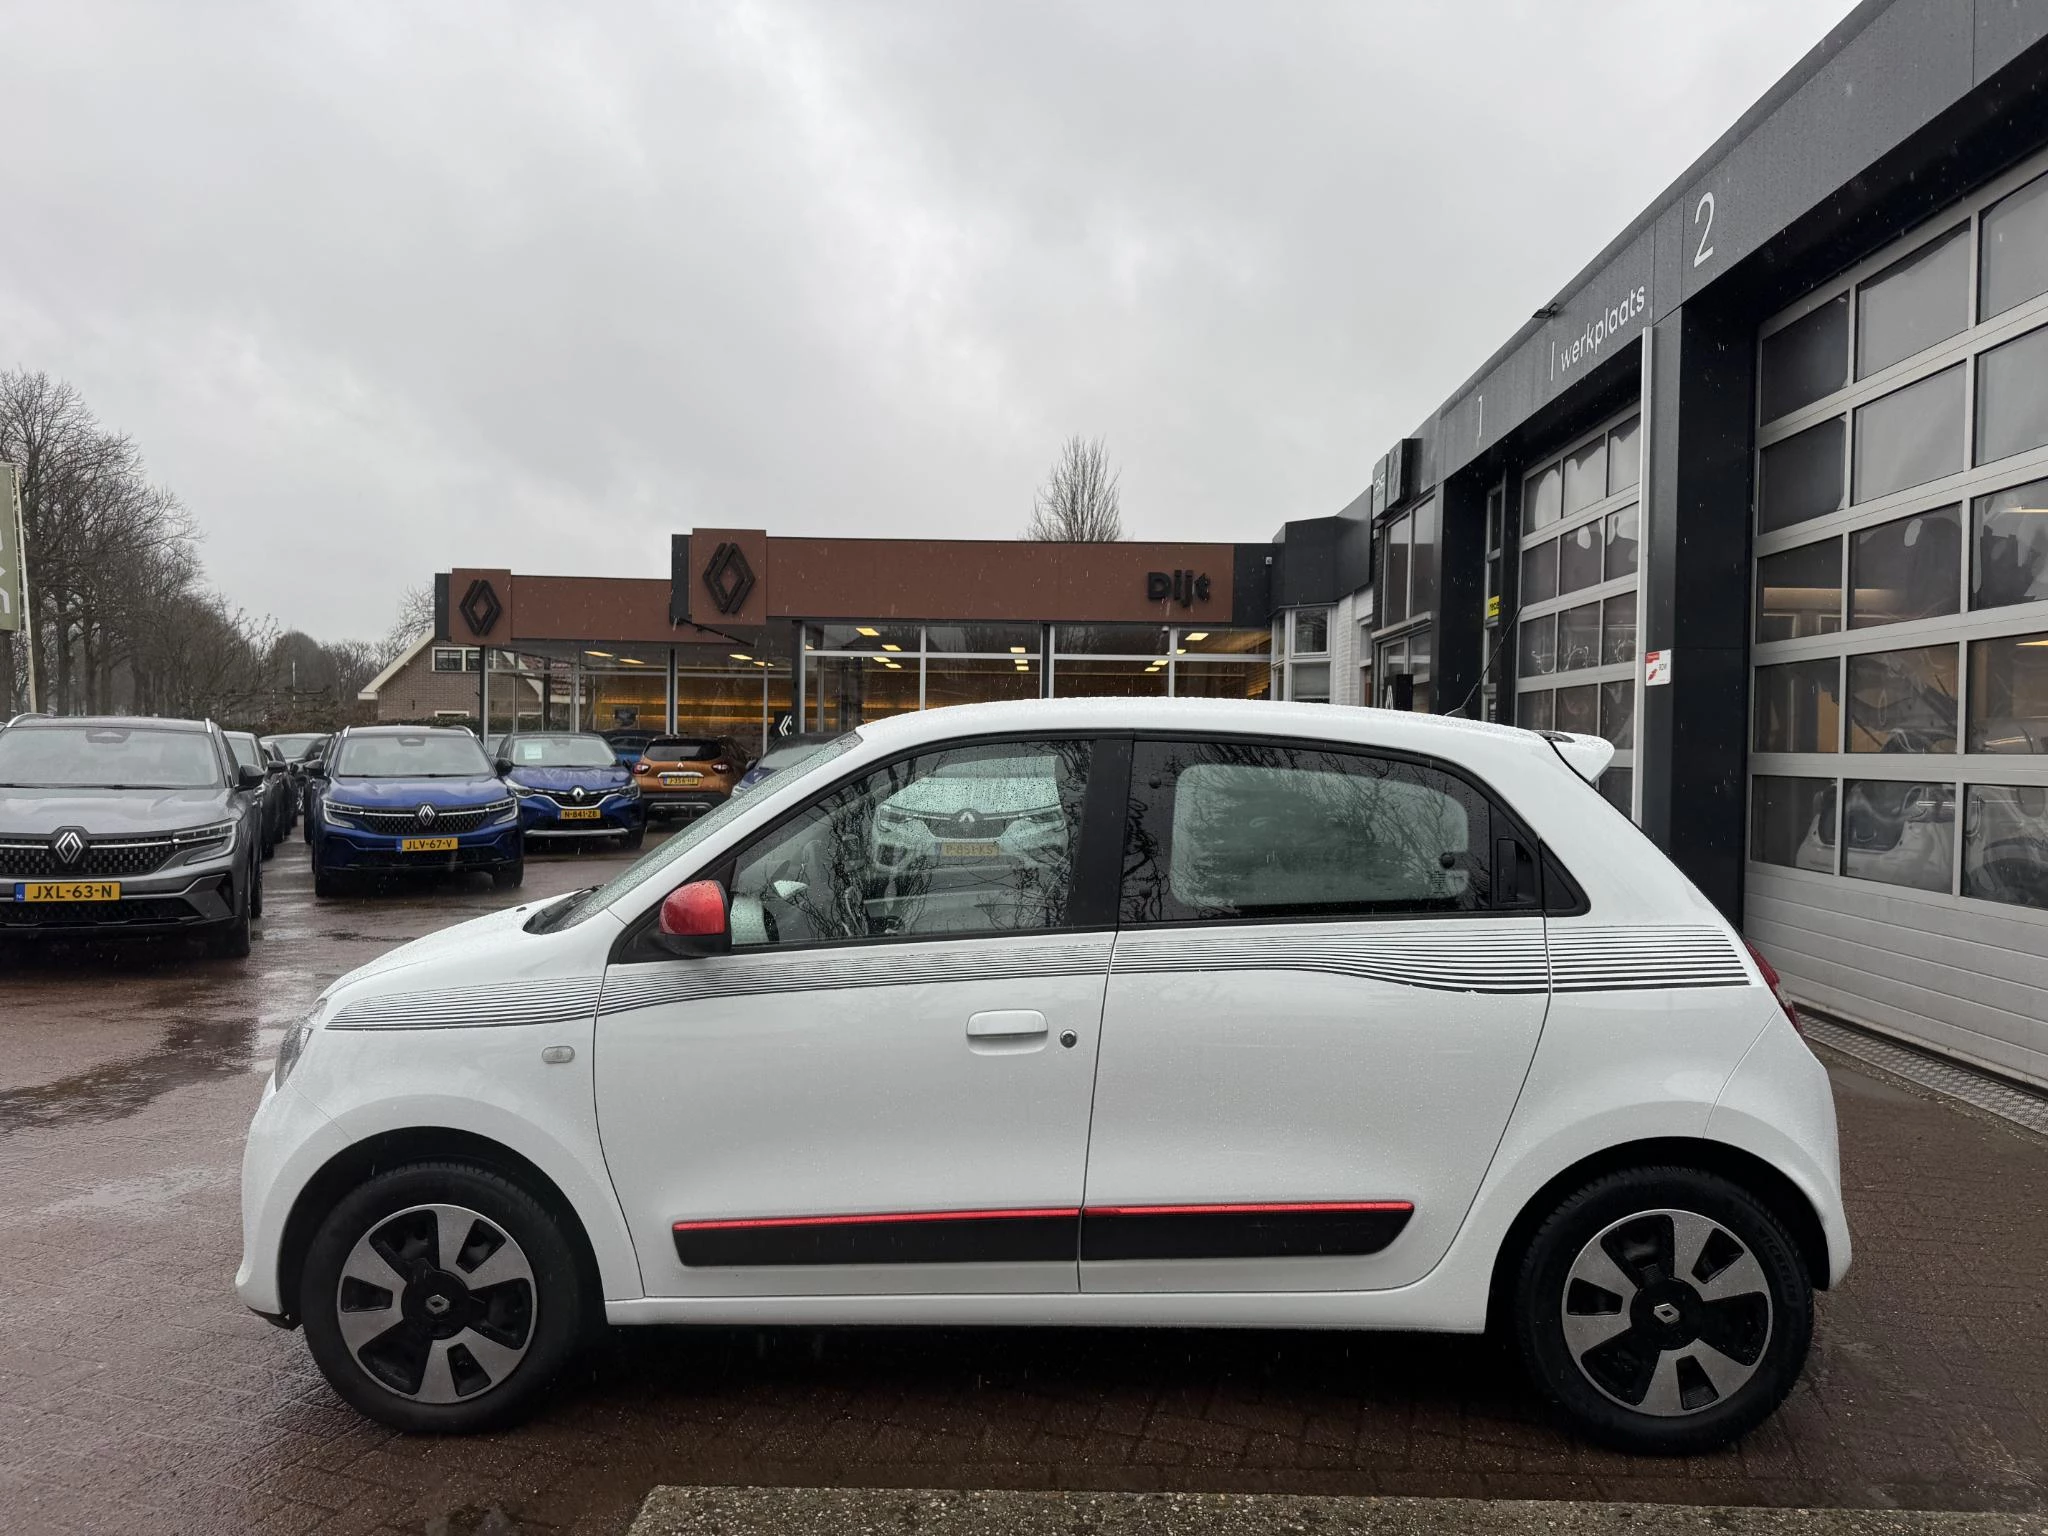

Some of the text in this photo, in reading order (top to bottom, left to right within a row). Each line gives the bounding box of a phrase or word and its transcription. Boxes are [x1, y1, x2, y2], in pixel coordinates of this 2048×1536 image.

[1693, 191, 1715, 269] 2
[1560, 285, 1646, 373] werkplaats
[1477, 395, 1484, 438] 1
[1147, 569, 1210, 609] Dijt
[406, 839, 453, 850] JLV-67-V
[33, 885, 113, 899] JXL-63-N
